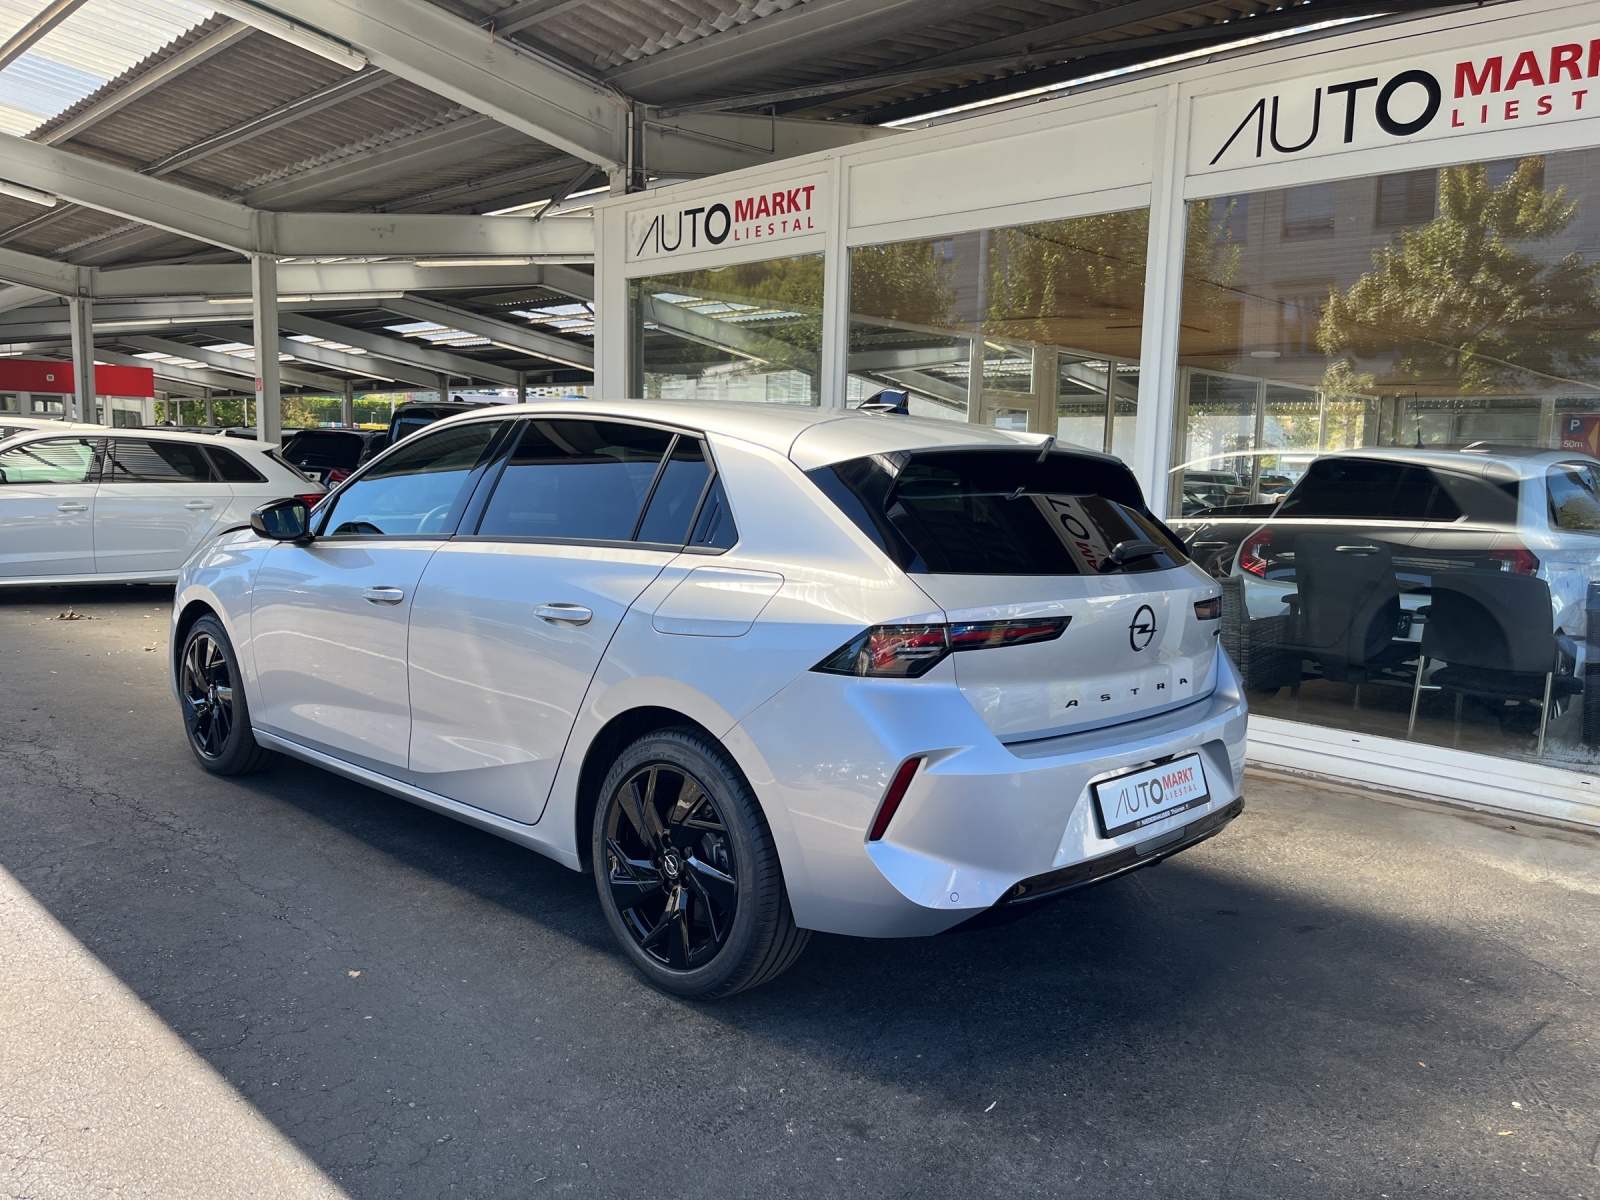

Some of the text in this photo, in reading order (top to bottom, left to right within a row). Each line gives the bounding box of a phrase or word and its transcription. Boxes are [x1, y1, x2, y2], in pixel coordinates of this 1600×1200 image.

[1208, 69, 1442, 166] AUTO
[636, 185, 815, 257] AUTO MARKT
[734, 216, 814, 241] LIESTAL
[1570, 419, 1580, 431] P
[1562, 440, 1583, 448] 50m
[1065, 677, 1188, 708] ASTRA
[1115, 778, 1164, 818] AUTO
[1162, 767, 1194, 790] MARKT
[1165, 784, 1197, 800] LIESTAL
